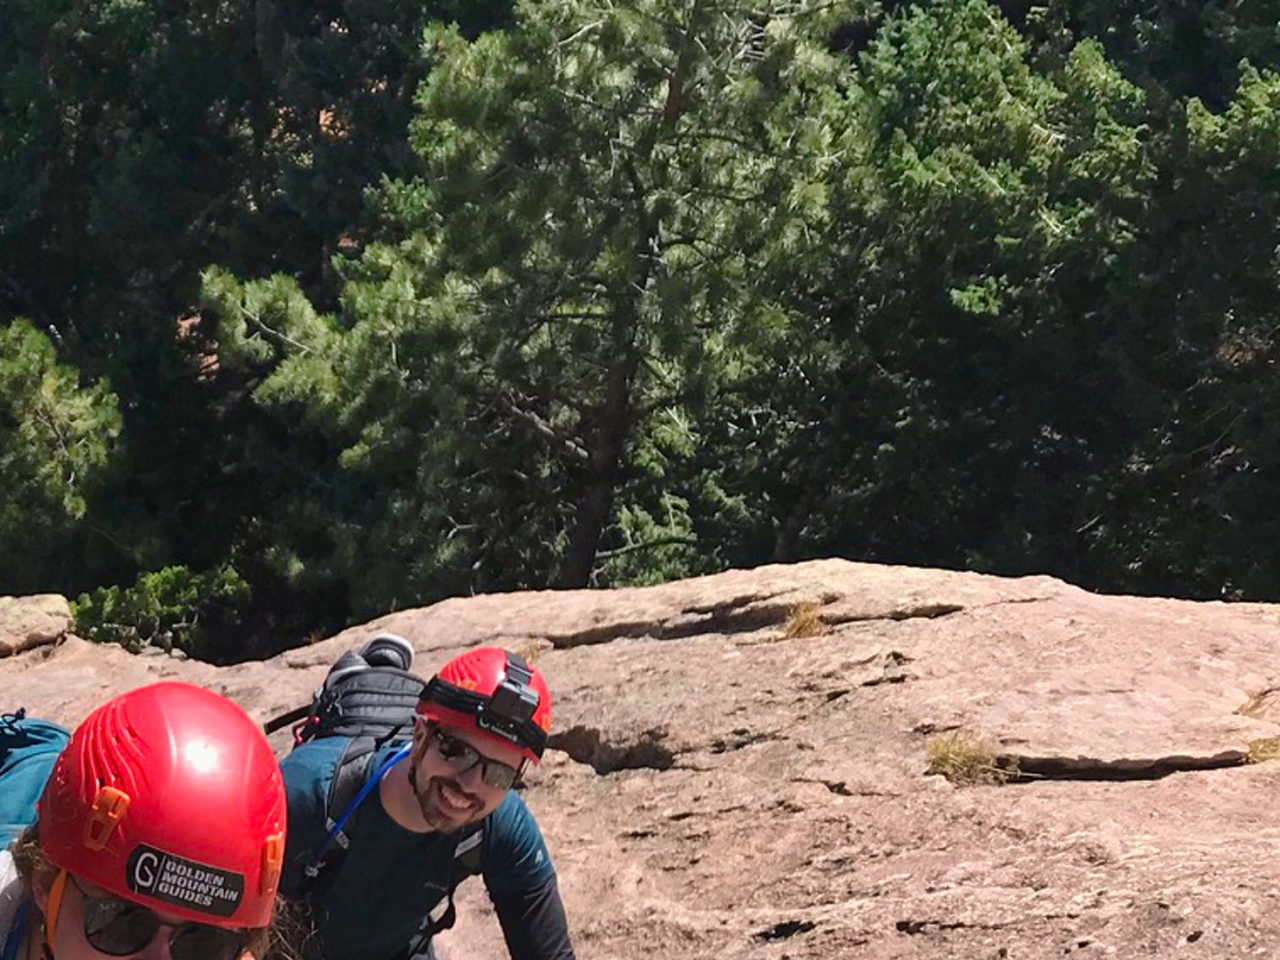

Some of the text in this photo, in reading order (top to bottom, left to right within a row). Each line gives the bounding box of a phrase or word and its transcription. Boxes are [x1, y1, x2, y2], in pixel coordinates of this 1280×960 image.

[165, 860, 224, 886] GOLDEN
[158, 882, 214, 907] GUIDES
[161, 871, 238, 902] MOUNTAIN
